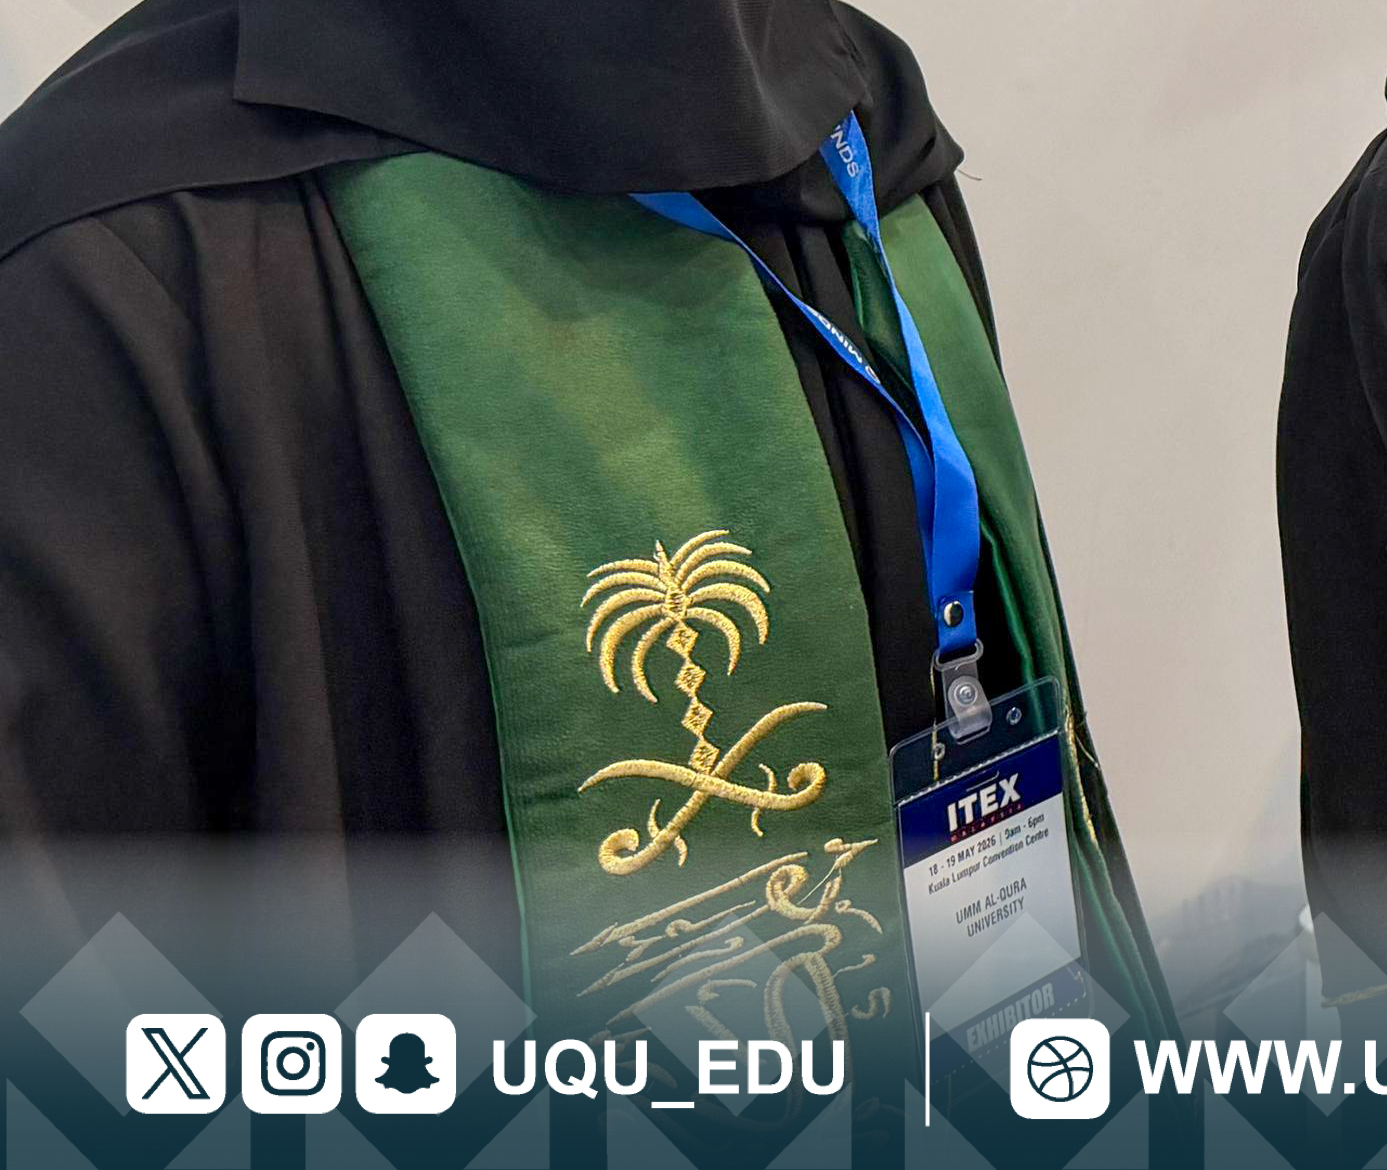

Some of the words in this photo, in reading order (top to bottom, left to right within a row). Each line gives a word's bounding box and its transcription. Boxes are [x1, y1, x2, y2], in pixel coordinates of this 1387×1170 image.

[947, 773, 1022, 832] ITEX
[928, 878, 951, 895] Kuala
[952, 862, 981, 884] Lumpur
[982, 838, 1024, 871] Convention
[1025, 827, 1050, 849] Centre
[928, 863, 939, 877] 18
[946, 854, 956, 868] 19
[957, 847, 976, 864] MAY
[955, 901, 982, 924] UMM
[984, 878, 1028, 911] AL-QURA
[967, 897, 1026, 938] UNIVERSITY
[965, 982, 1056, 1051] EXHIBITOR
